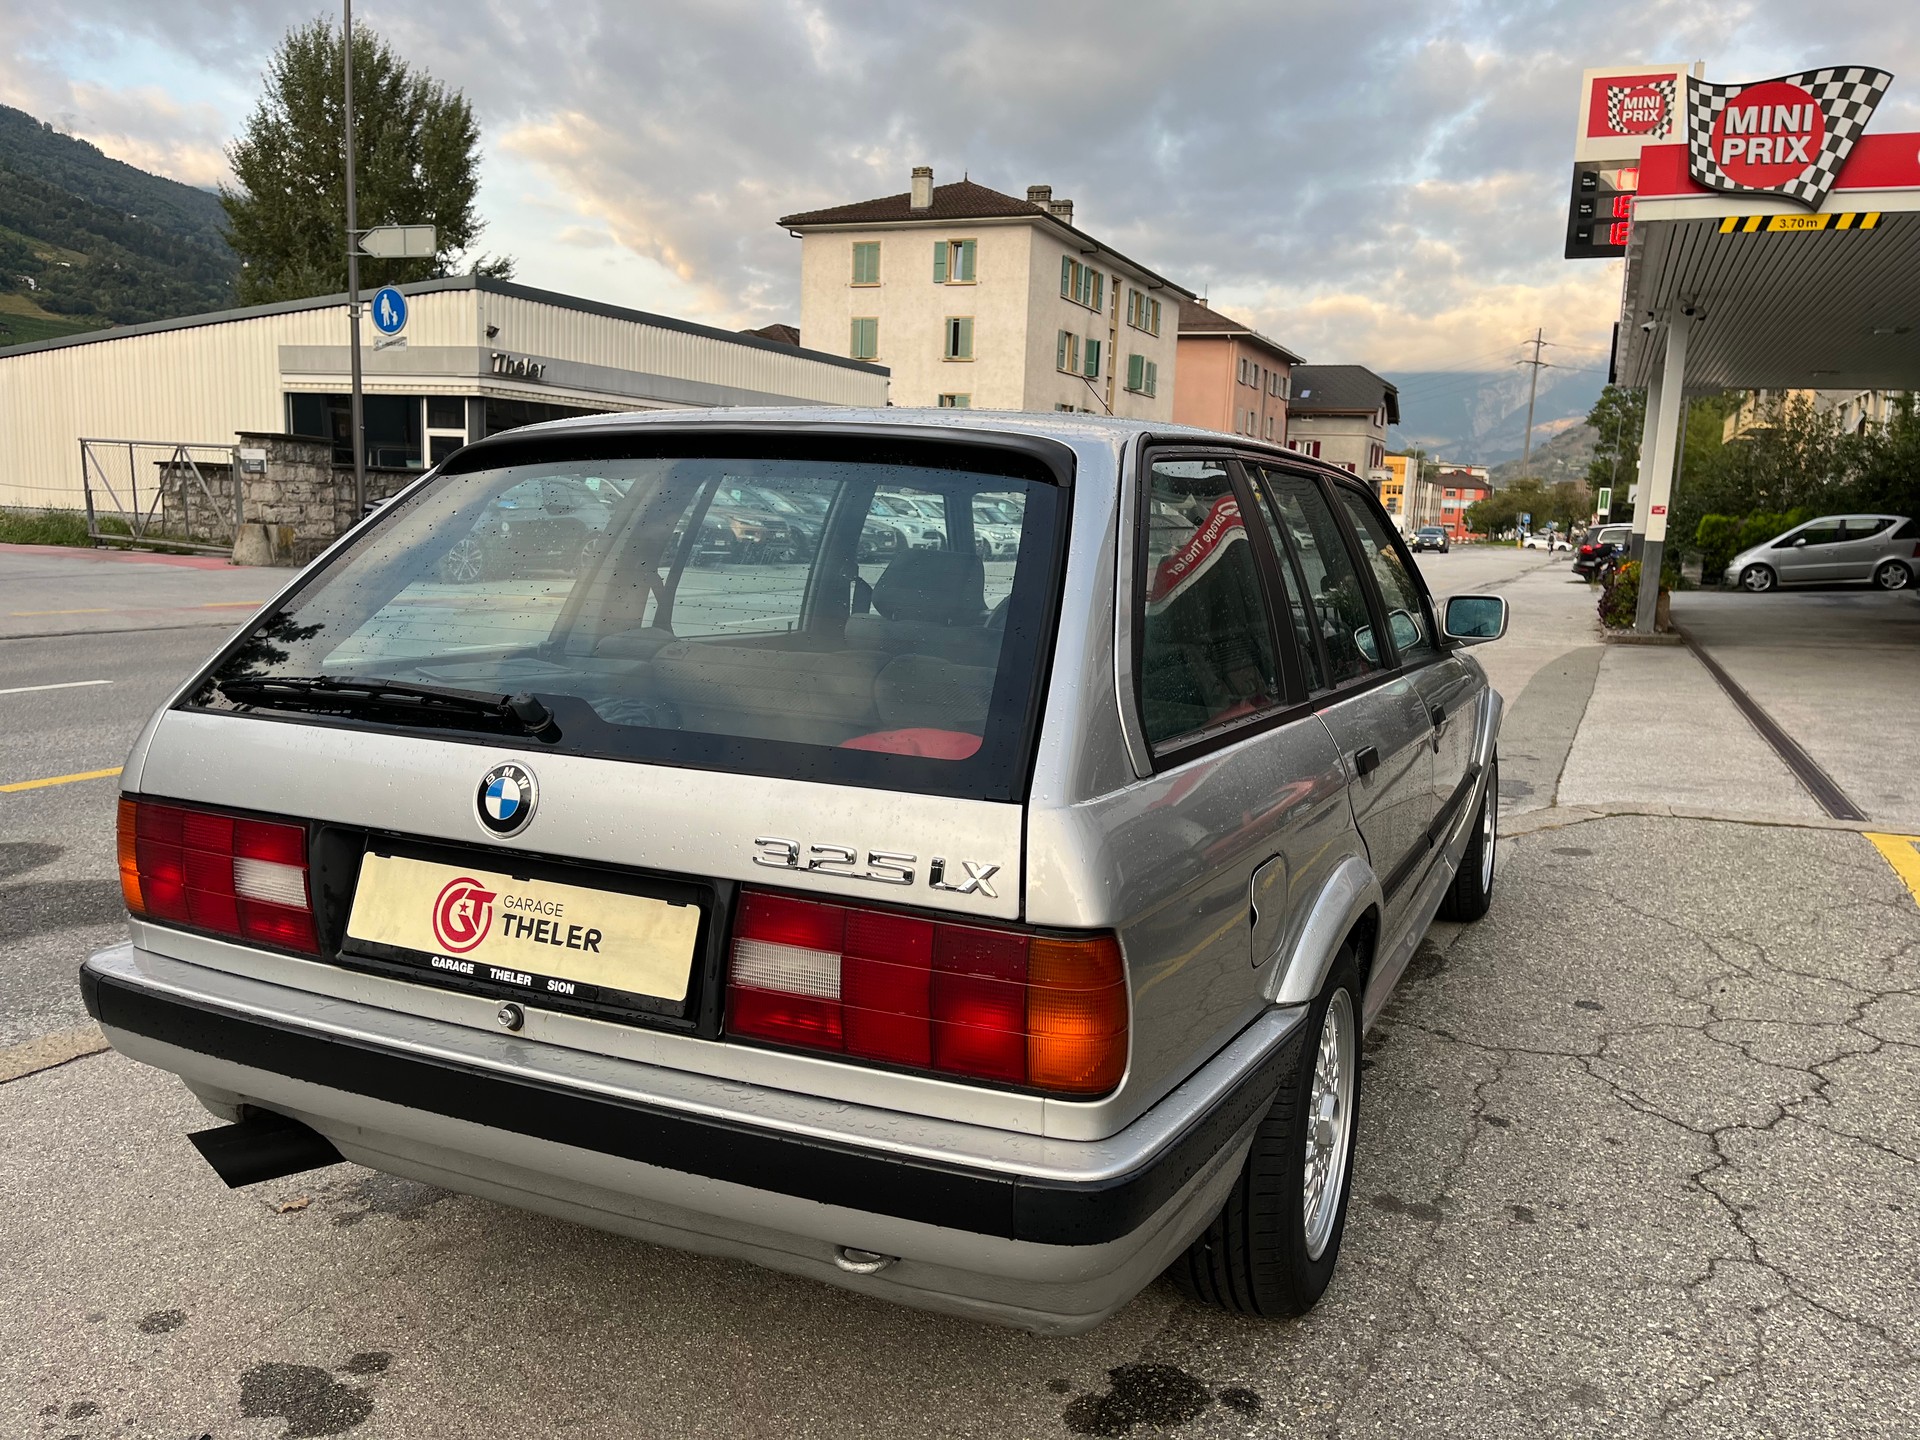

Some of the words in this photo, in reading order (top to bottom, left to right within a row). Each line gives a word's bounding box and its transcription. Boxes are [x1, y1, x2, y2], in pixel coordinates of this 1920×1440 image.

[1624, 95, 1660, 109] MINI
[1622, 109, 1659, 122] PRIX
[1724, 103, 1814, 135] MINI
[1721, 135, 1812, 165] PRIX
[1779, 218, 1805, 229] 3.70
[1806, 220, 1818, 228] m
[491, 352, 546, 378] Theler
[486, 766, 530, 790] BMW
[503, 894, 564, 918] GARAGE
[501, 912, 603, 953] THELER
[431, 956, 475, 975] GARAGE
[489, 967, 532, 987] THELER
[546, 979, 575, 995] SION
